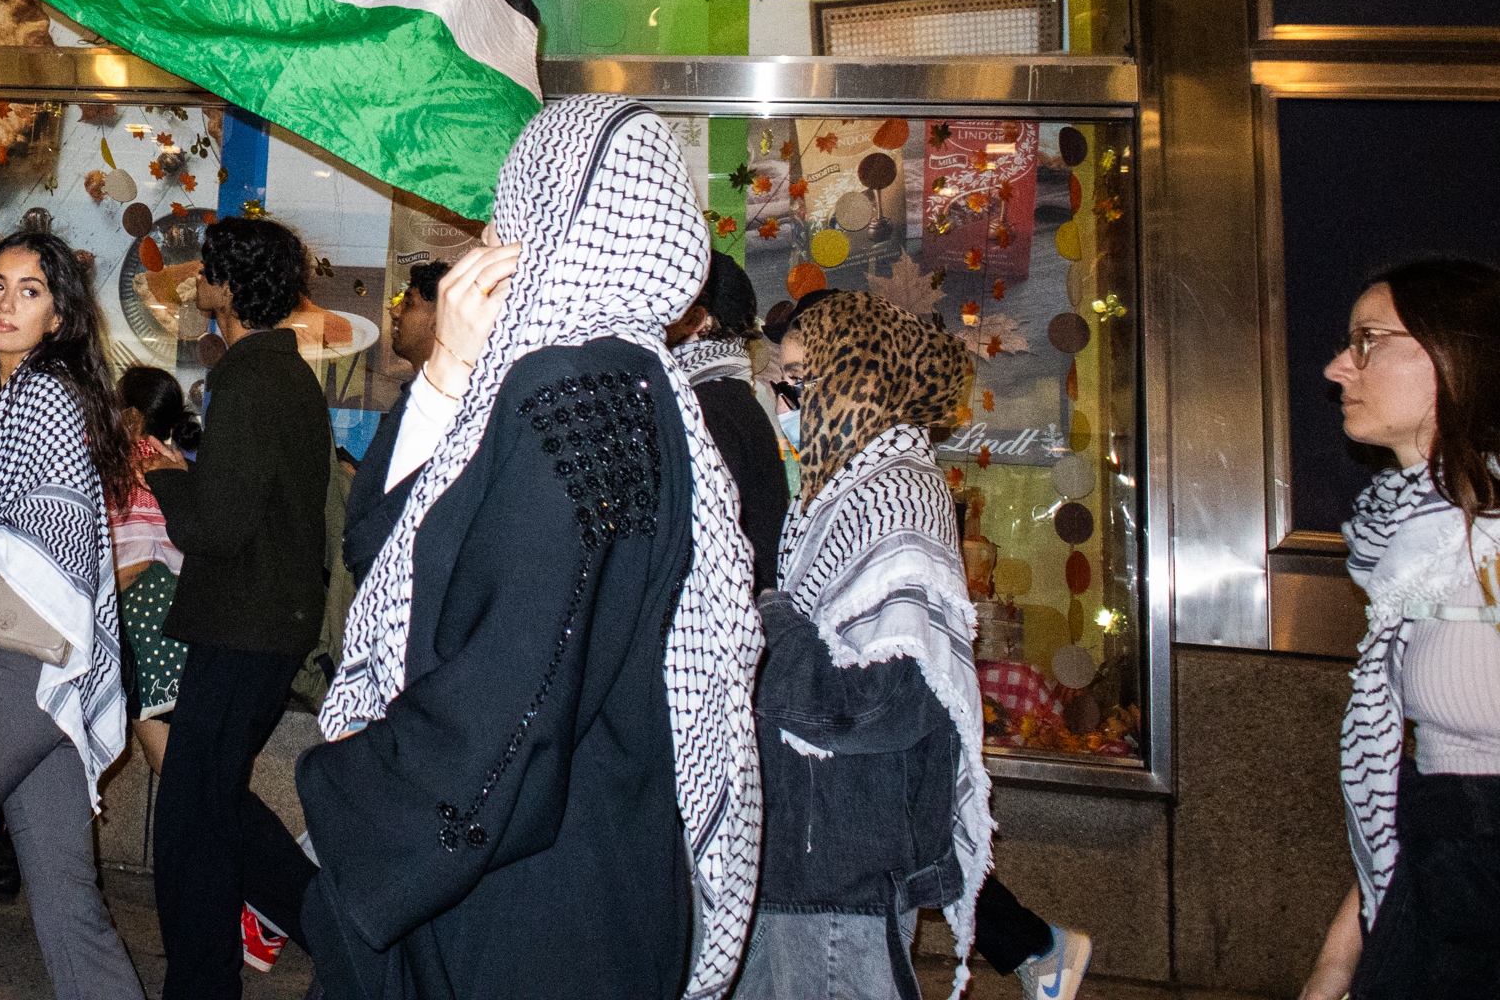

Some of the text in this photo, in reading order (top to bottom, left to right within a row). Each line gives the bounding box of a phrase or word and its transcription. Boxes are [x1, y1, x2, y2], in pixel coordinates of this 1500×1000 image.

[837, 133, 872, 146] NDOR
[937, 156, 958, 167] MILK
[398, 252, 430, 264] ASSORTED
[937, 422, 1039, 455] Lindt
